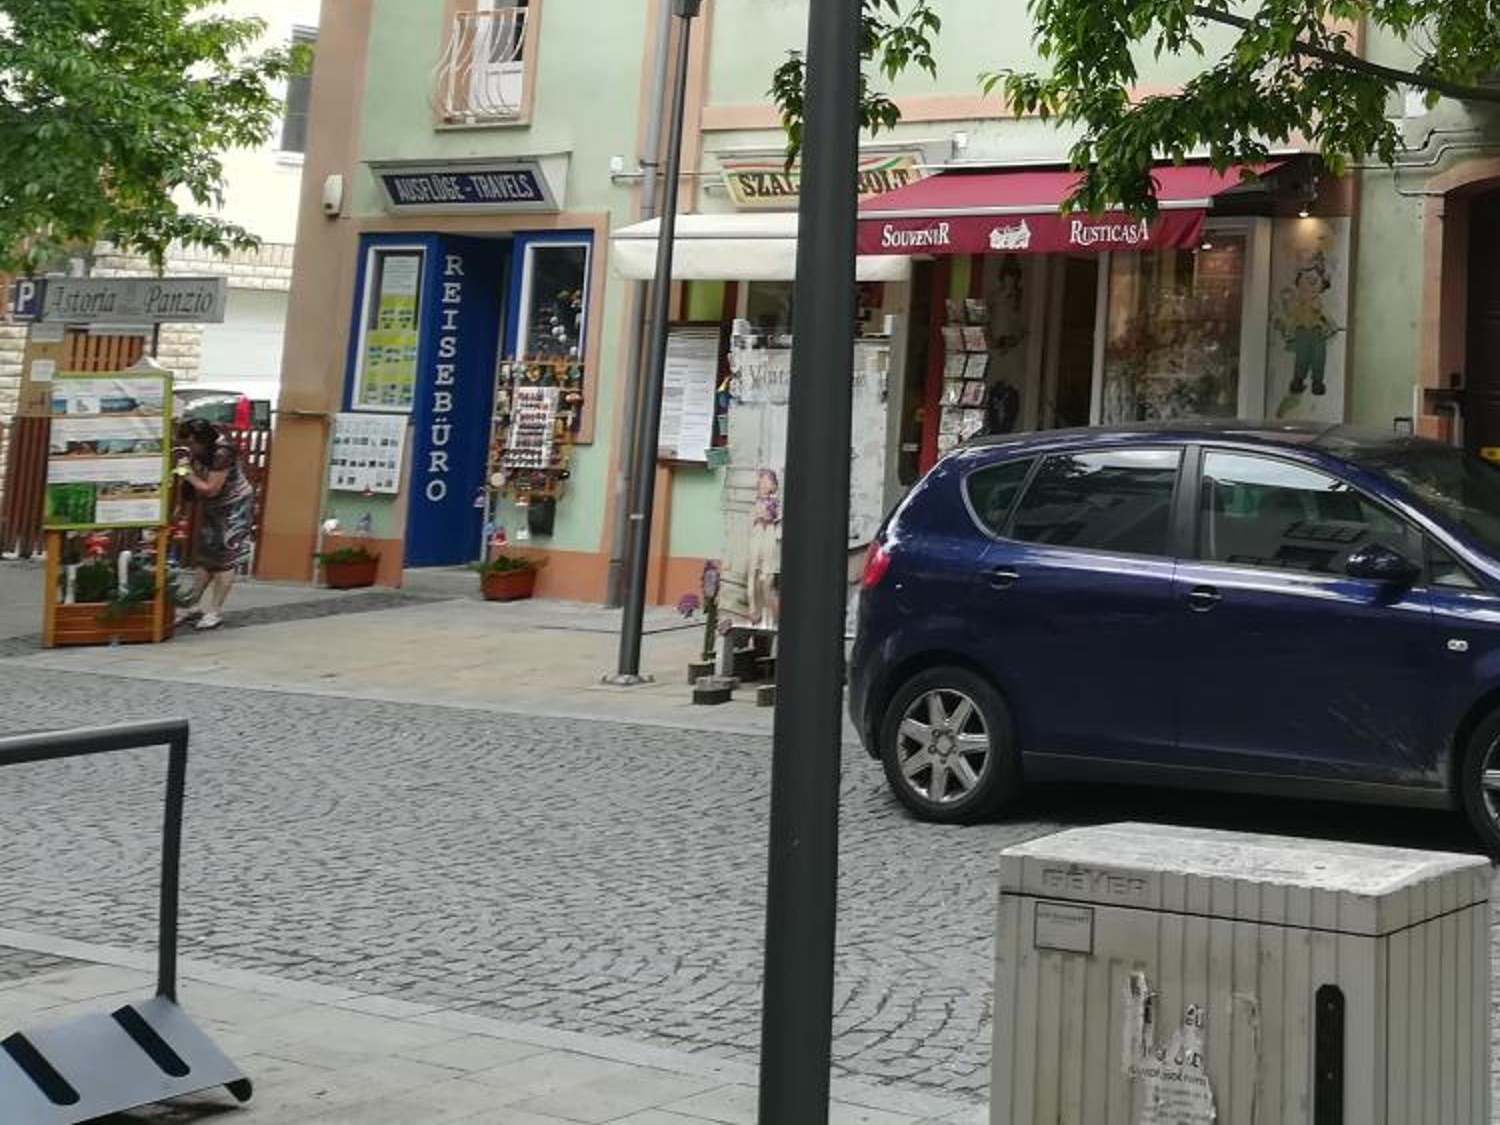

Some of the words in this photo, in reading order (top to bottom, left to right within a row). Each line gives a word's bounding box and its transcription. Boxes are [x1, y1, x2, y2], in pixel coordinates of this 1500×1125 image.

[395, 175, 465, 201] AUSFLÜGE
[470, 175, 534, 199] TRAVELS
[18, 281, 34, 313] P
[425, 254, 465, 502] REISEBÜRO
